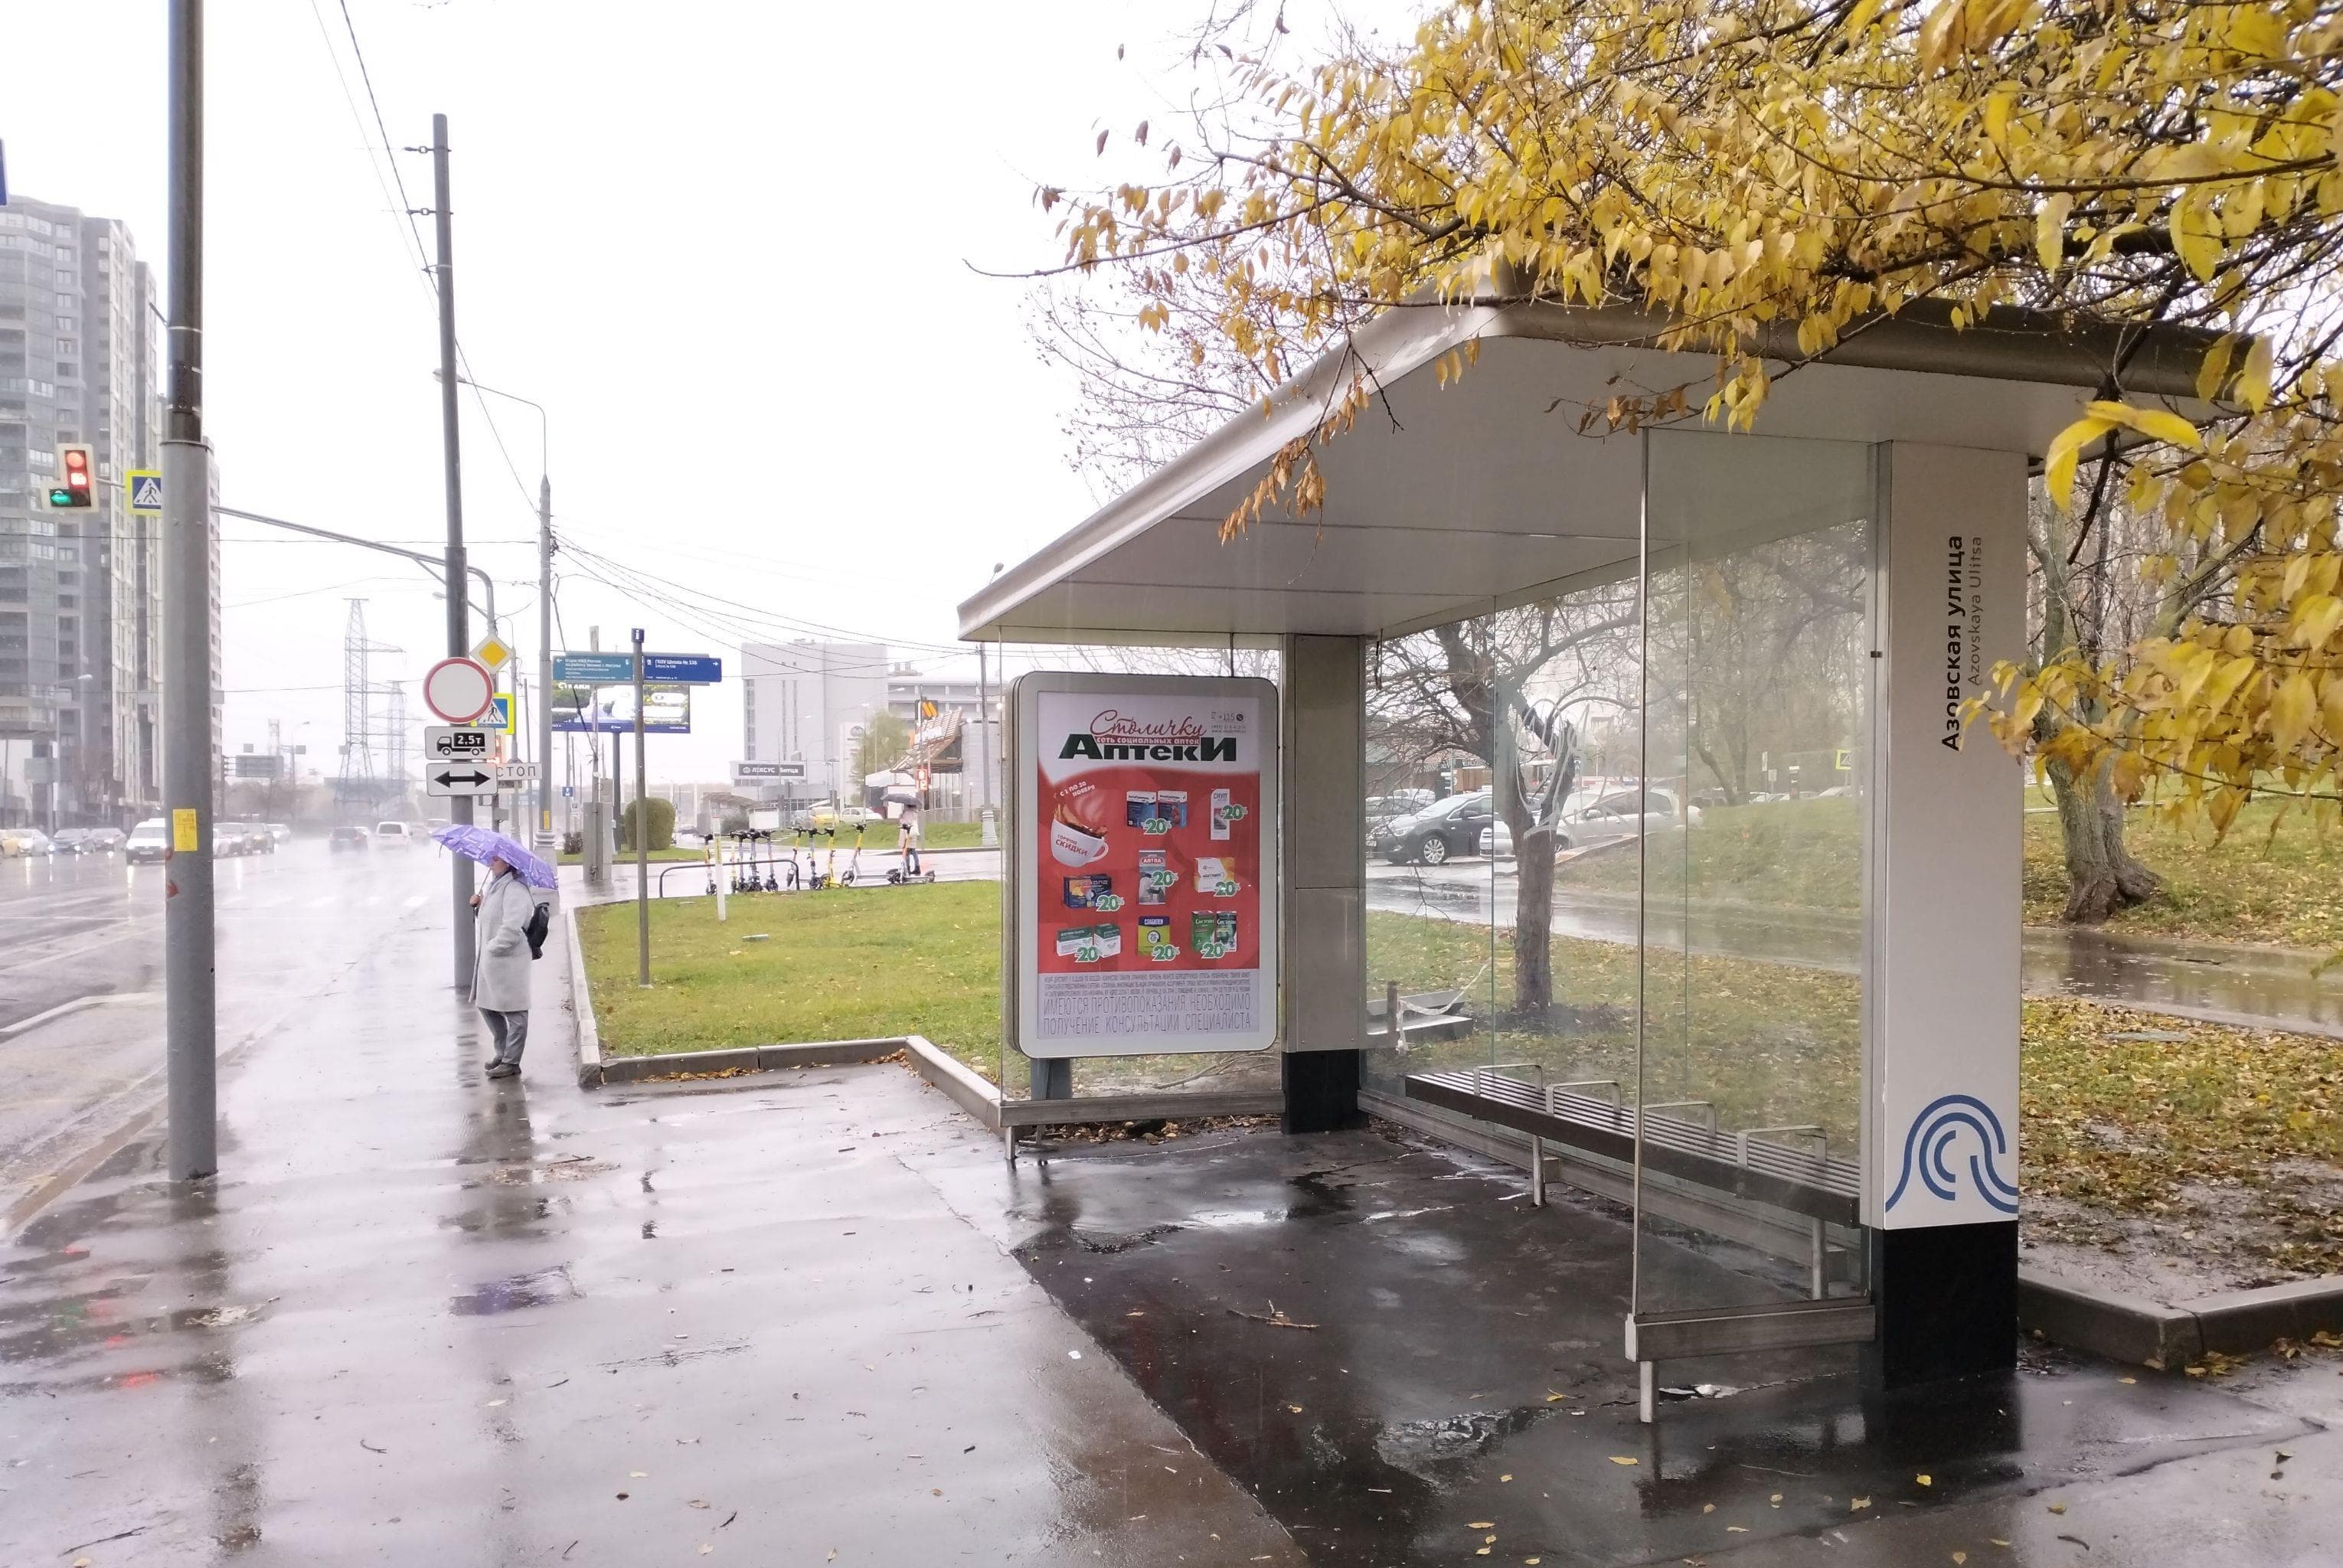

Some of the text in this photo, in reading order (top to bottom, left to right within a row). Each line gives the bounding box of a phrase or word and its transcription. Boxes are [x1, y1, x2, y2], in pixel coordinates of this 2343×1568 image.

[1968, 537, 1984, 686] Azovskaya Ulitsa
[1942, 536, 1966, 751] Азовская улица
[1090, 710, 1207, 736] Столички
[496, 766, 536, 777] СТОП
[1056, 839, 1088, 857] СКИДКИ
[1044, 997, 1088, 1015] ИМЕЮТСЯ
[1190, 992, 1250, 1011] НЕОБХОДИМО
[1044, 1011, 1250, 1035] ПОЛУЧЕНИЕ КОНСУЛЬТАЦИИ СПЕЦИАЛИСТА
